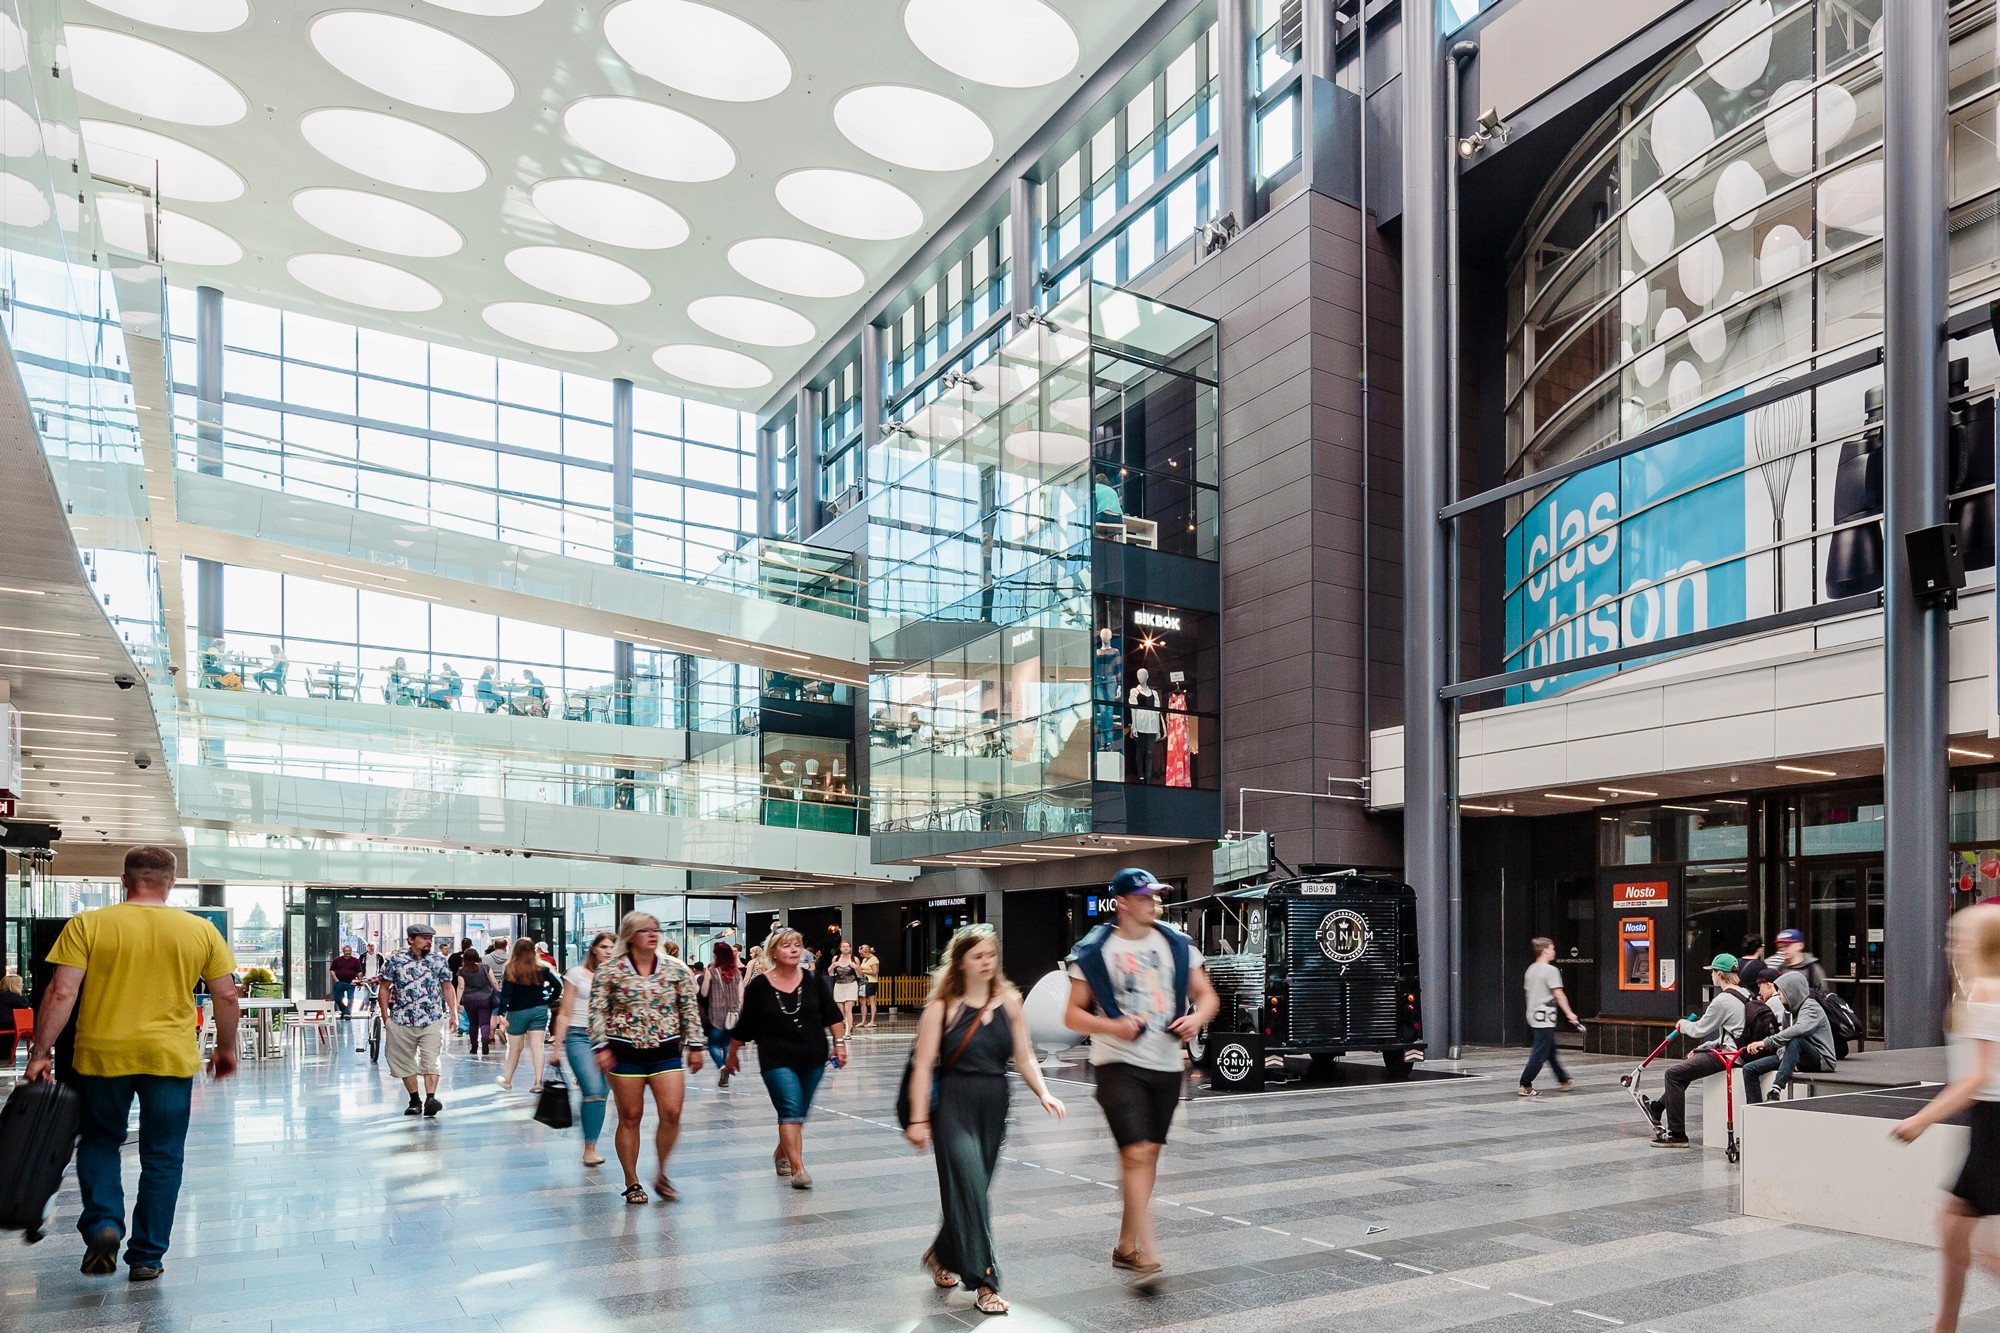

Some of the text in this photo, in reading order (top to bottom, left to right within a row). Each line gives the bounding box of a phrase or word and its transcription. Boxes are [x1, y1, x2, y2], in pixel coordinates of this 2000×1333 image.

[1528, 491, 1618, 602] clas
[1528, 560, 1708, 693] ohlson
[1625, 886, 1656, 898] Nosto
[1098, 898, 1118, 912] KIO
[1625, 923, 1647, 932] Nosto
[1315, 930, 1374, 941] FONUM
[1217, 1057, 1253, 1067] FONUM
